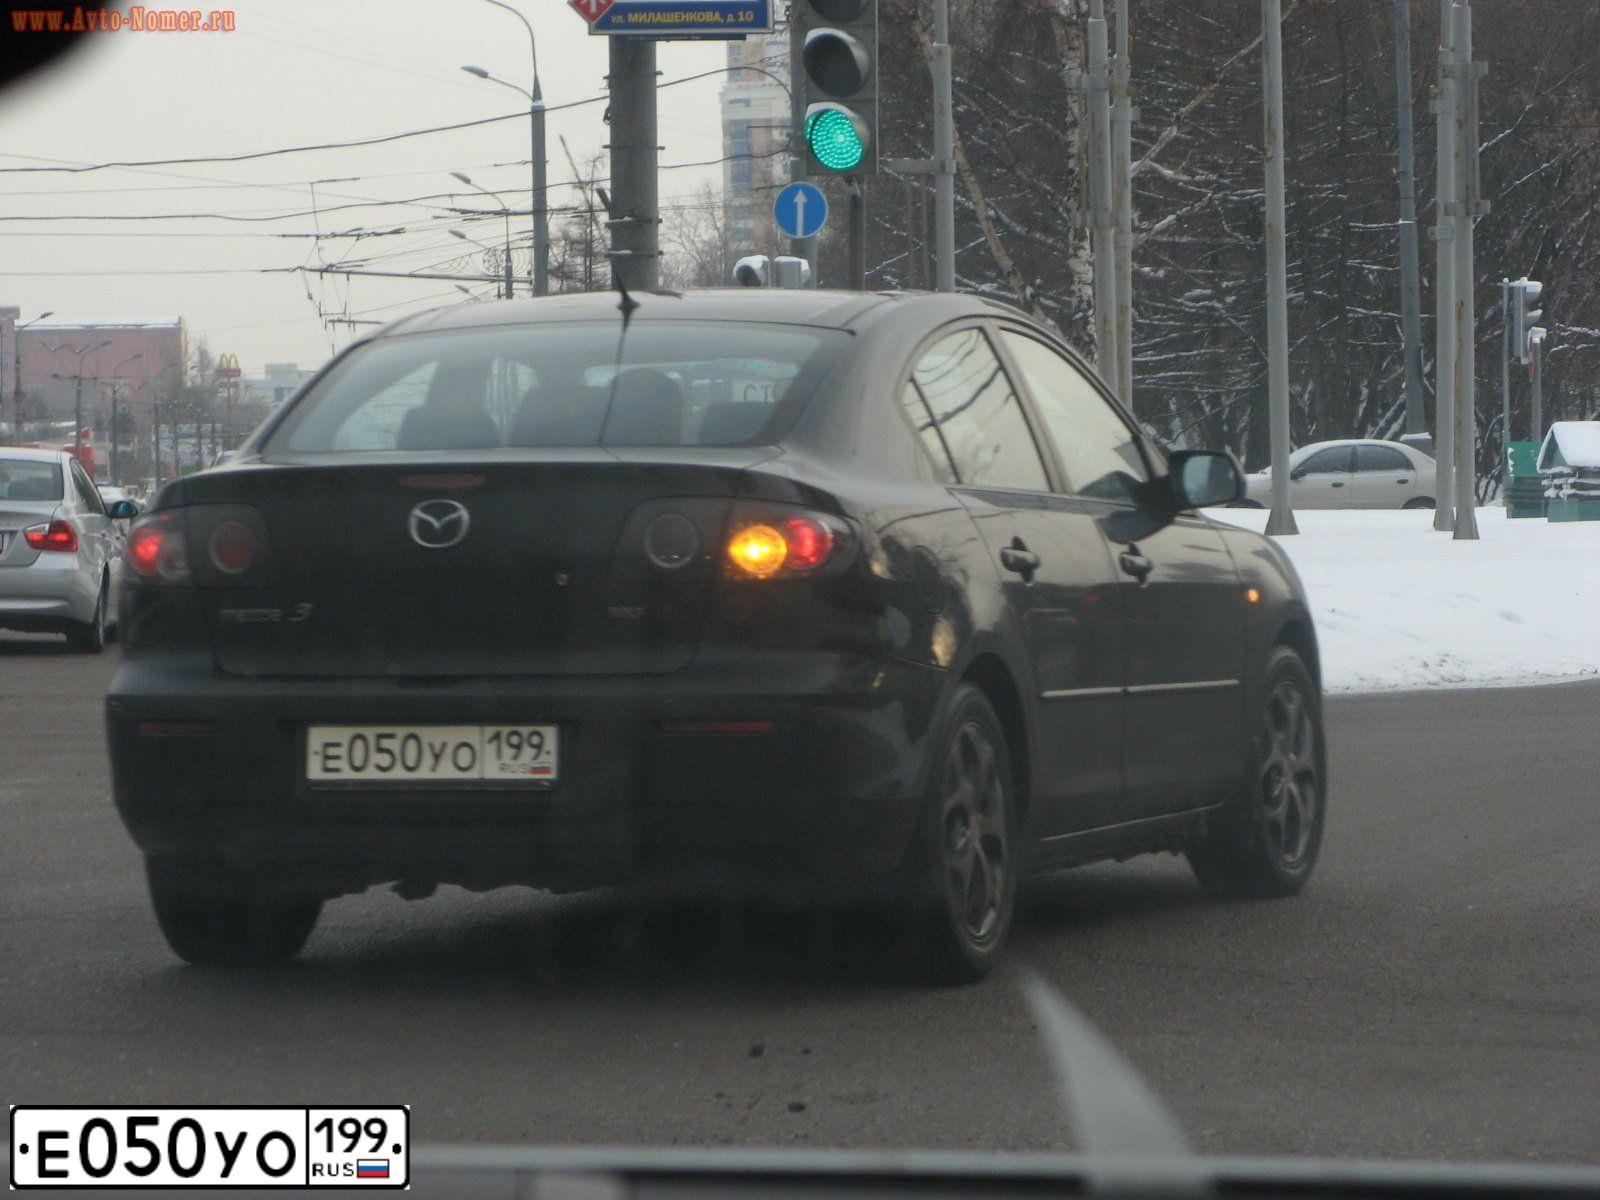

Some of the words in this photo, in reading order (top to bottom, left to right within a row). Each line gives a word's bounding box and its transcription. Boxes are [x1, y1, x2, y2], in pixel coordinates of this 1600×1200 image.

[611, 14, 625, 24] ул.
[738, 11, 755, 22] 10
[487, 729, 545, 761] 199
